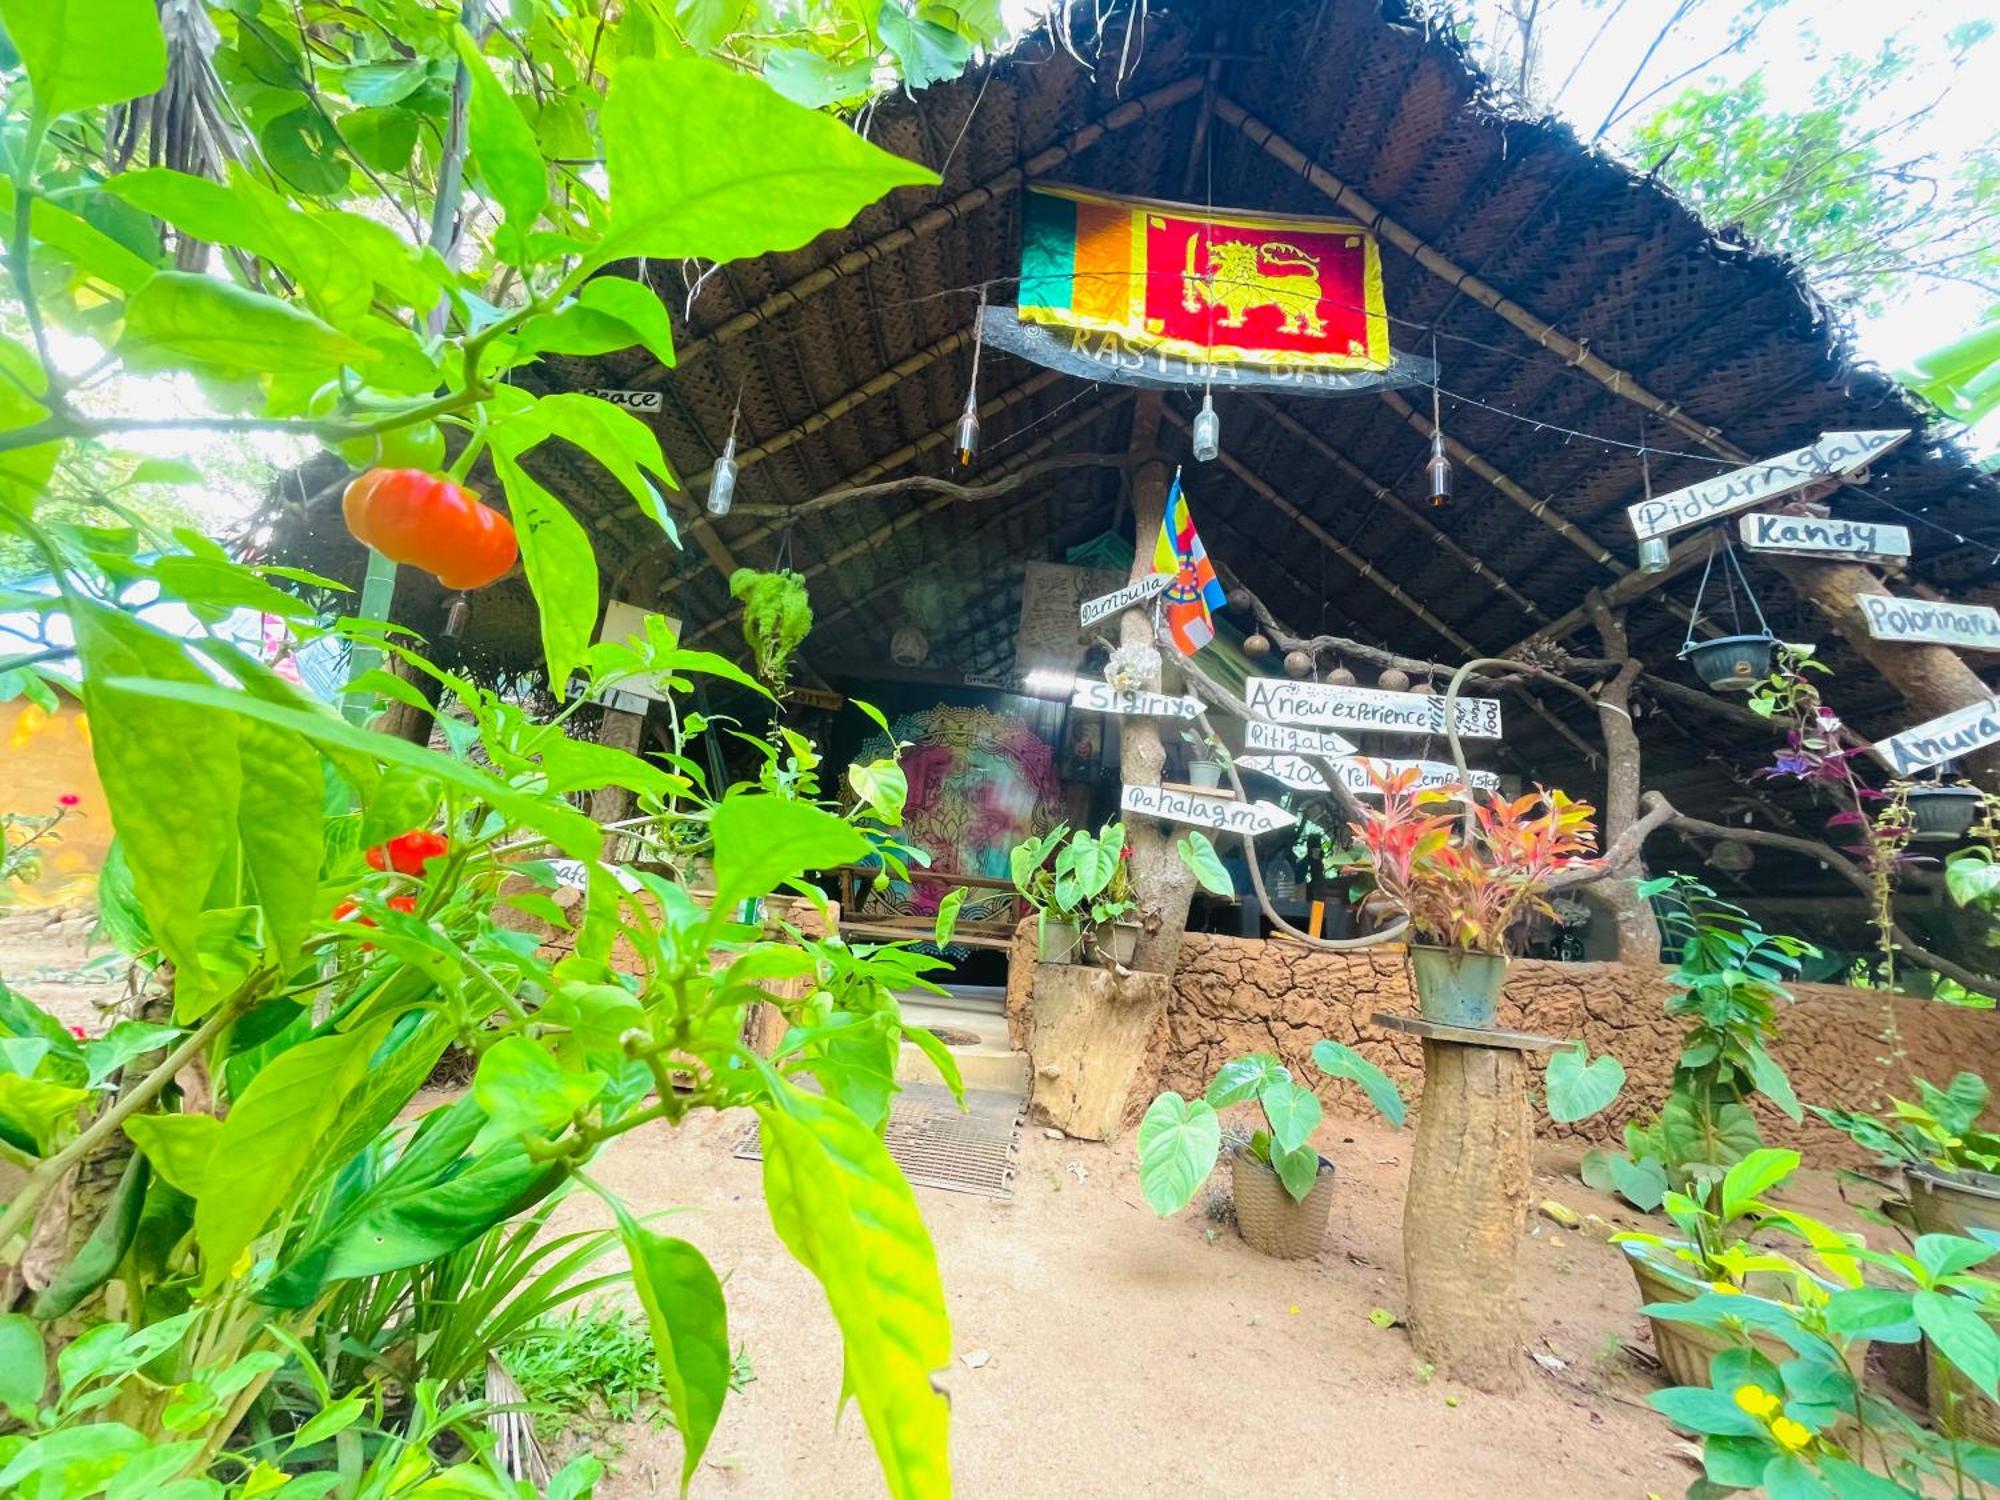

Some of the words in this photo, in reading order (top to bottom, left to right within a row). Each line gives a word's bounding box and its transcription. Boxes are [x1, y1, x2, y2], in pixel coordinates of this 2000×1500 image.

[1757, 516, 1877, 557] Kandy
[1082, 577, 1163, 624] Dambulla
[1089, 681, 1197, 716] Sigiriya
[1250, 681, 1278, 720] A
[1278, 698, 1328, 716] new
[1481, 700, 1499, 736] food
[1251, 723, 1342, 754] Ritigala
[1890, 717, 2000, 777] Anura
[1129, 788, 1274, 832] Pahalagma
